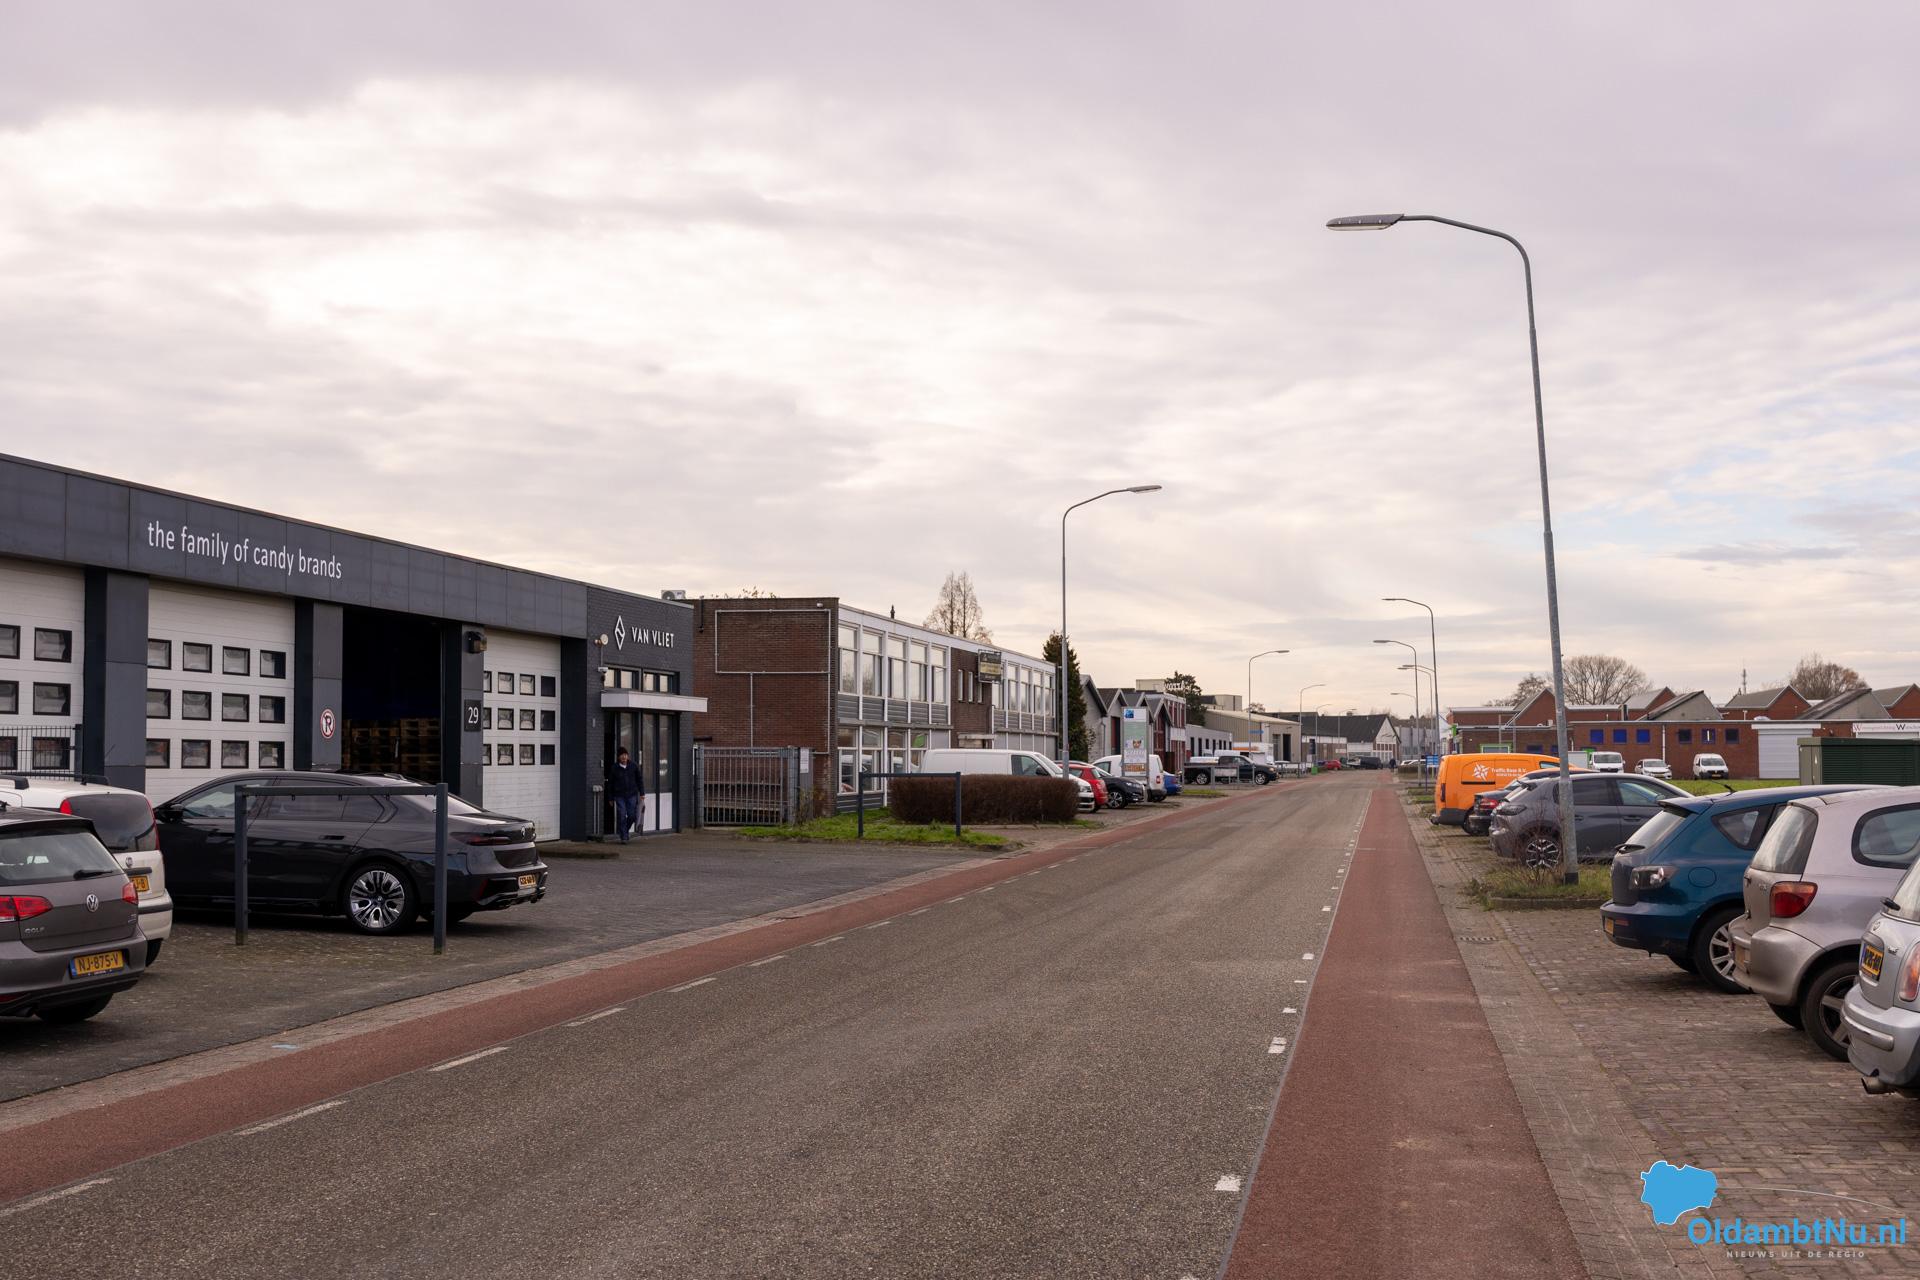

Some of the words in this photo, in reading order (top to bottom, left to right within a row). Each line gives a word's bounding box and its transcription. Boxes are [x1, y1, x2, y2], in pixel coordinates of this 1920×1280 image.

[147, 520, 175, 550] the
[180, 525, 229, 565] family
[233, 538, 250, 563] of
[253, 546, 294, 576] candy
[299, 548, 342, 579] brands
[631, 626, 649, 644] VAN
[651, 629, 675, 649] VLIET
[467, 706, 479, 724] 29
[24, 926, 46, 935] GOLF
[77, 952, 120, 972] NJ-875-V
